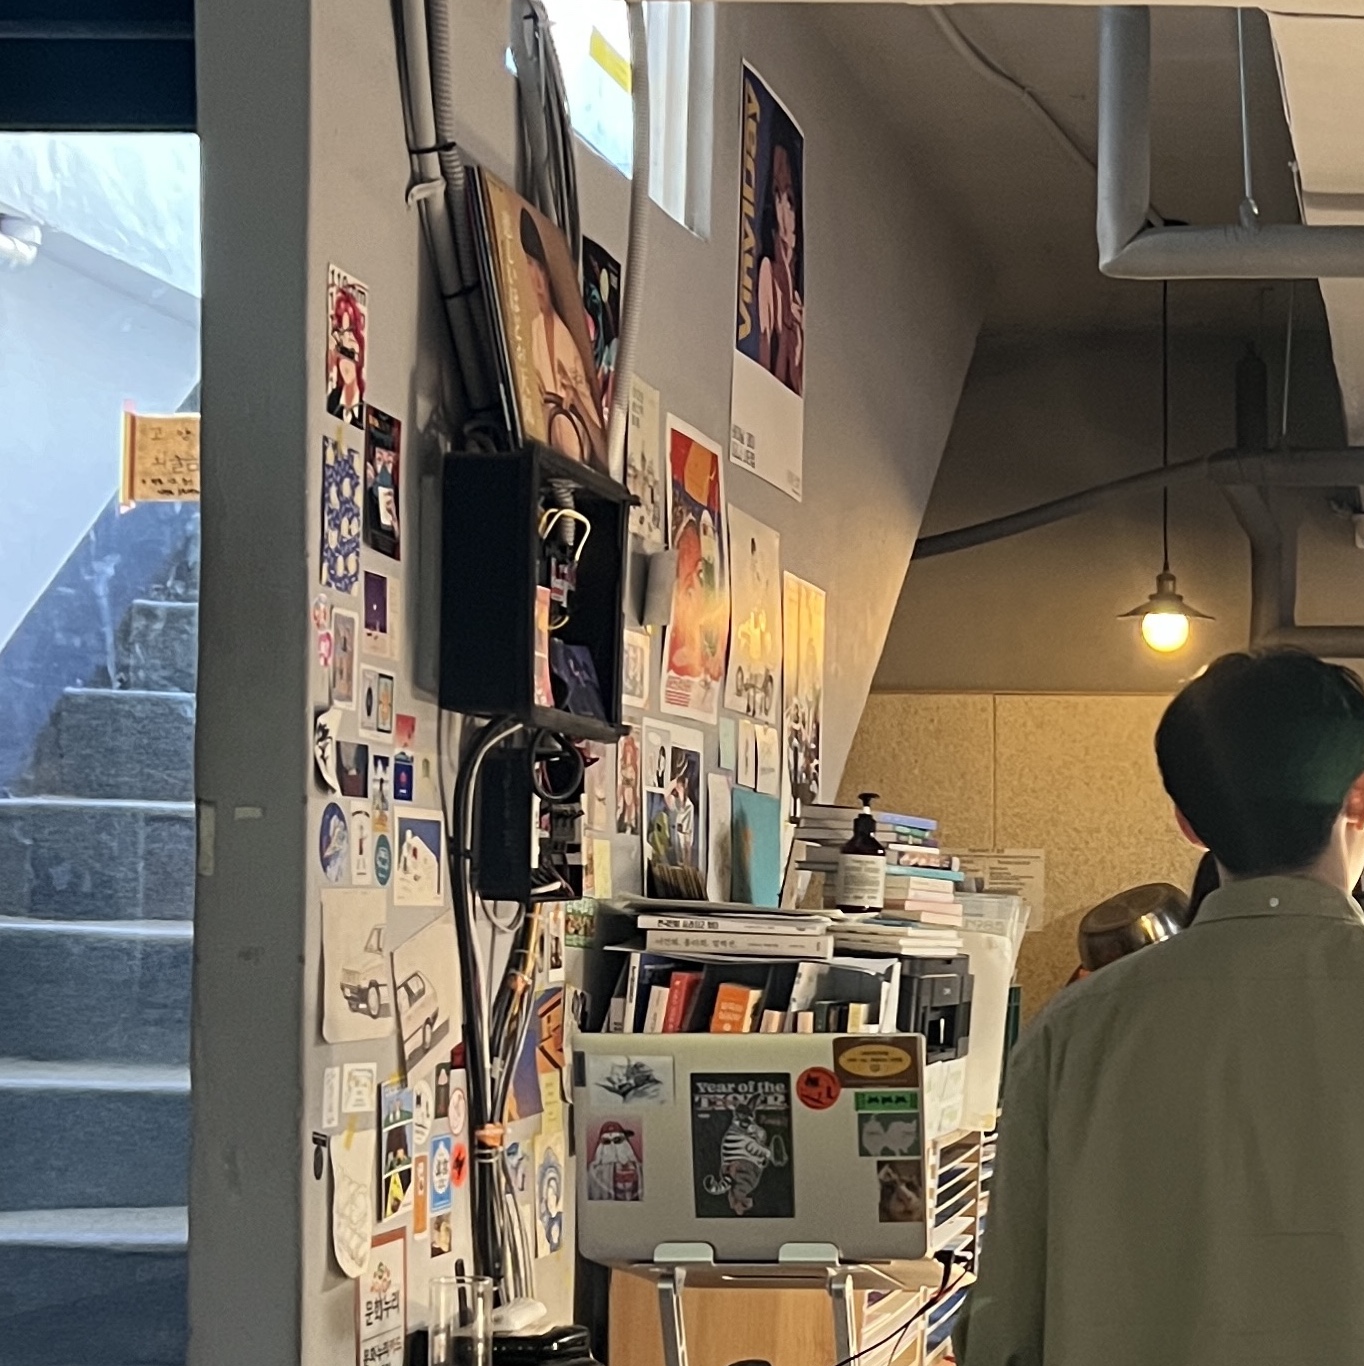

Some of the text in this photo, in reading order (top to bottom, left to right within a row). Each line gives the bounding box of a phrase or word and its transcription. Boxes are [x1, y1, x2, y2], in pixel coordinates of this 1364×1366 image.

[695, 1080, 786, 1094] Year of the
